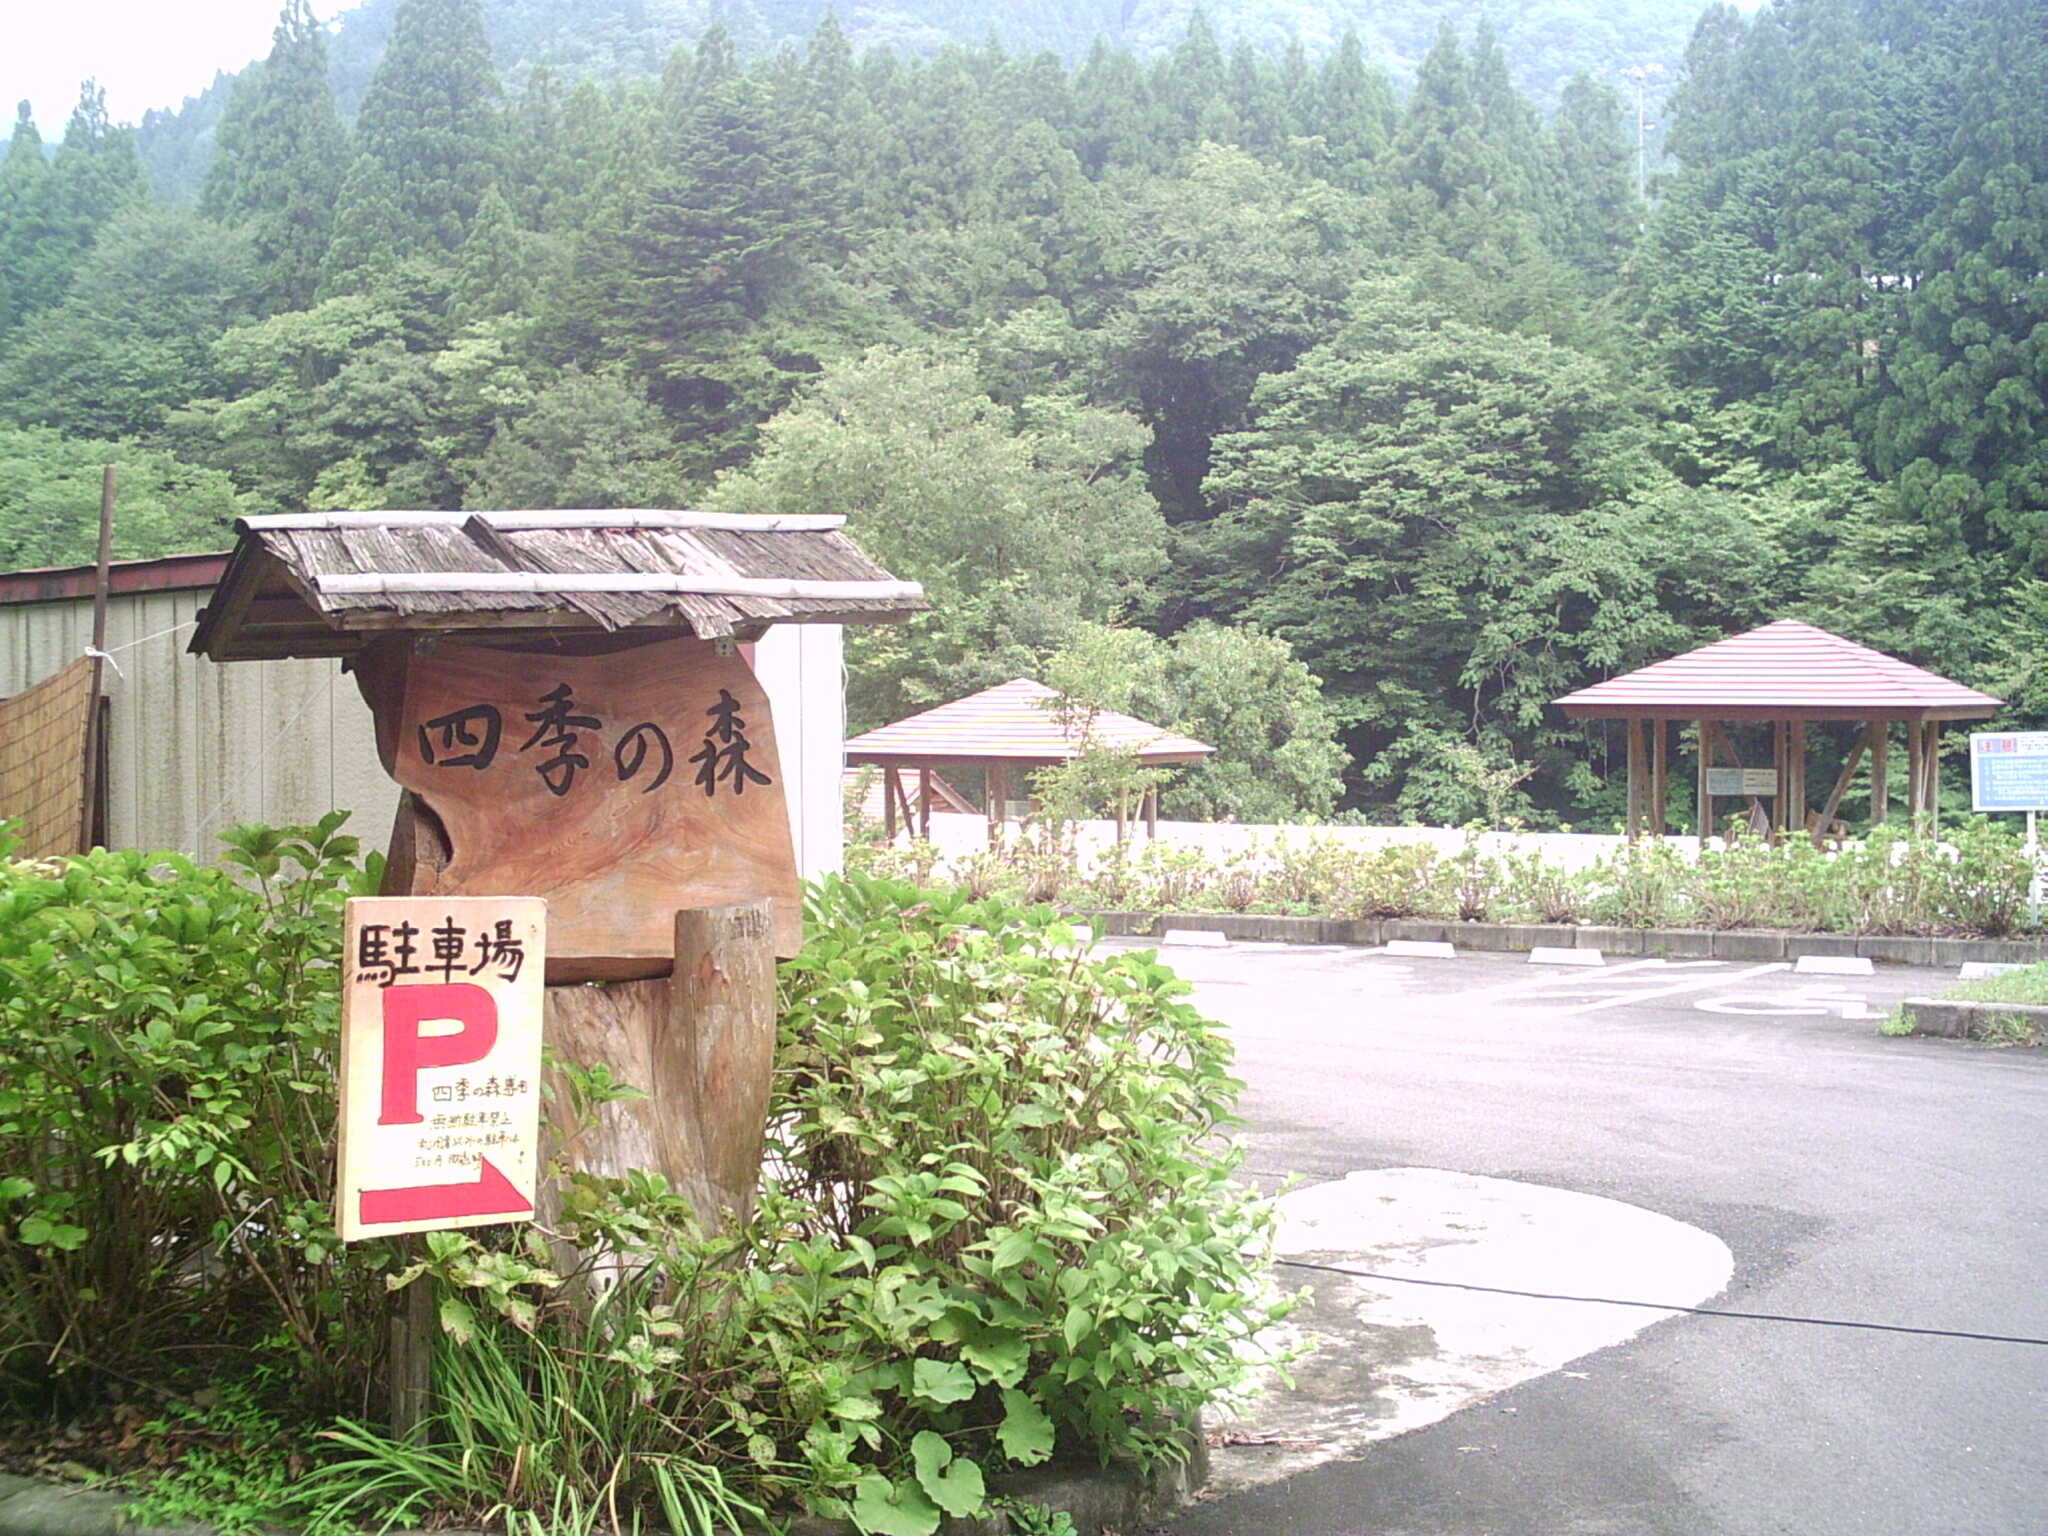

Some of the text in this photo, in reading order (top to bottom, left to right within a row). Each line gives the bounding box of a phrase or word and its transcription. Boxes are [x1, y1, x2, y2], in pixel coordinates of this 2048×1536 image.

[417, 683, 772, 797] 四季の森
[356, 916, 525, 988] 駐車場
[378, 982, 499, 1126] P
